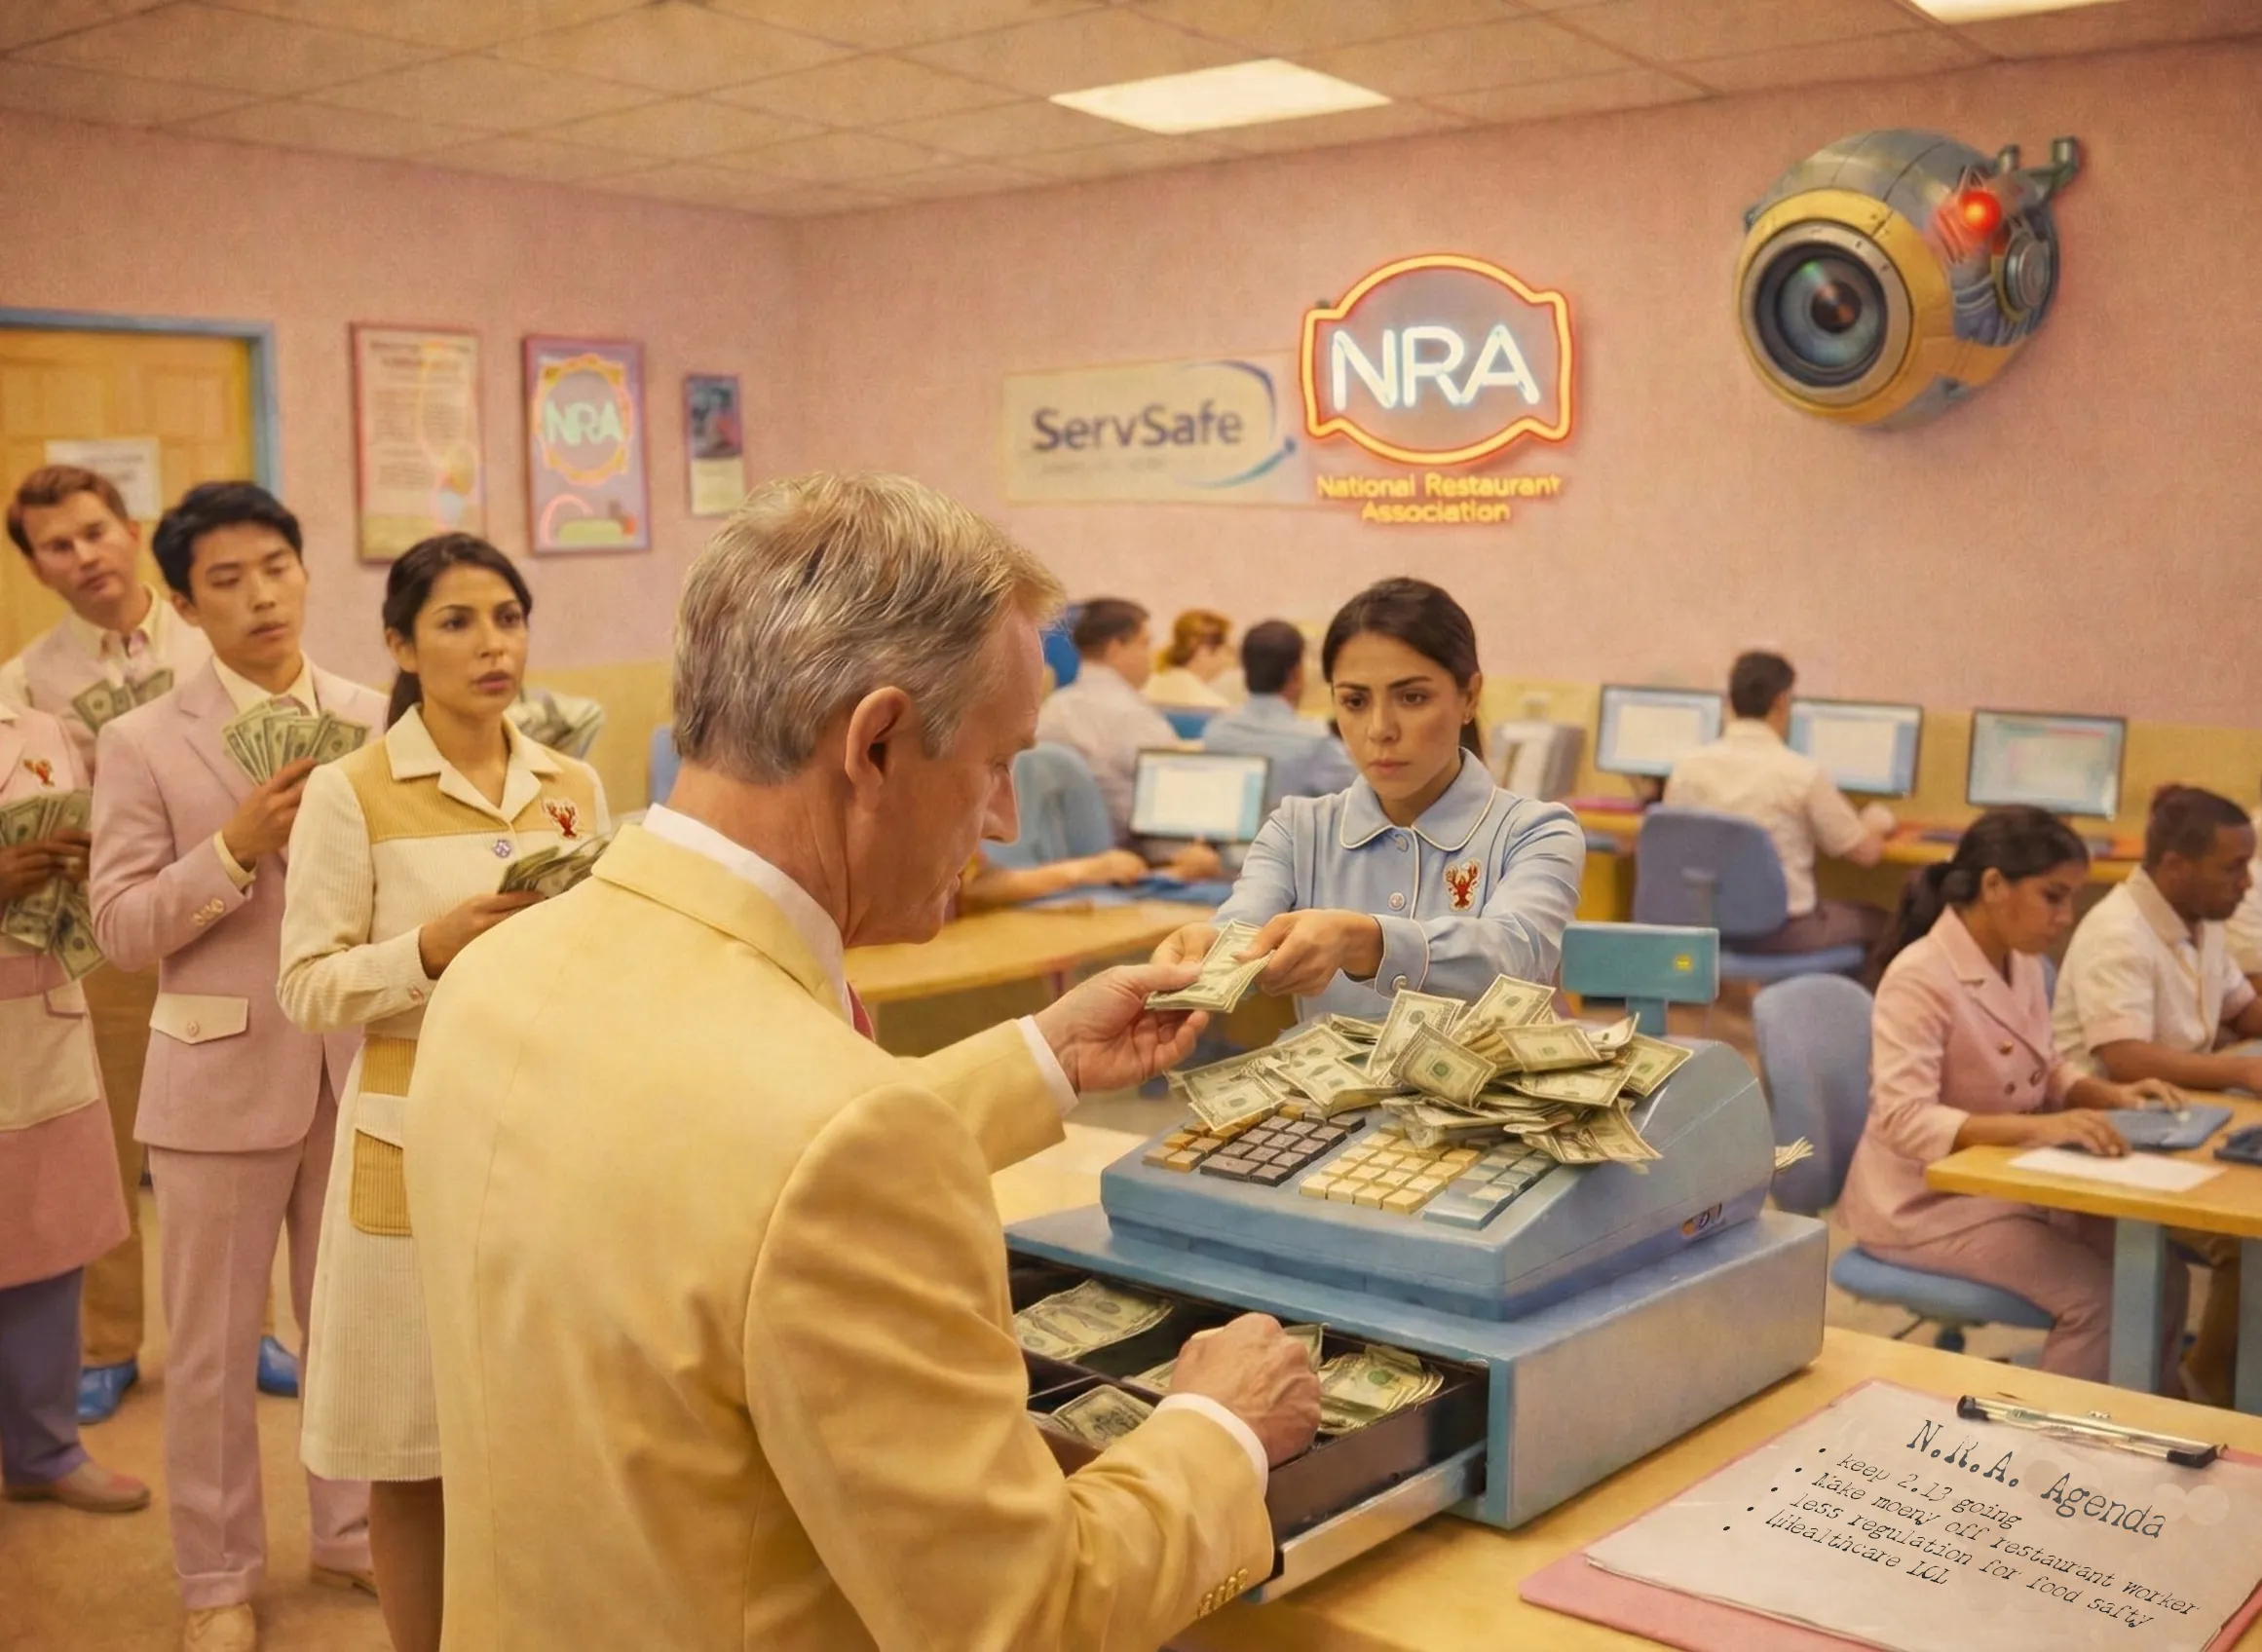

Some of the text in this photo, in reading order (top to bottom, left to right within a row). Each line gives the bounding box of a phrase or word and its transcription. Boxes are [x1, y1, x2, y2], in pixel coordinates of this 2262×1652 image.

[1332, 323, 1542, 412] NRA
[544, 399, 624, 446] NRA
[1031, 398, 1245, 451] ServSafe
[1316, 472, 1562, 498] National Restaurant
[1361, 500, 1510, 523] Association
[1836, 1453, 2022, 1529] keep 2.13 going
[1906, 1419, 2166, 1538] N.R.A. Agenda
[1790, 1493, 2154, 1628] less regulation for food safty
[1811, 1473, 2200, 1614] Make moeny off restaurant worker
